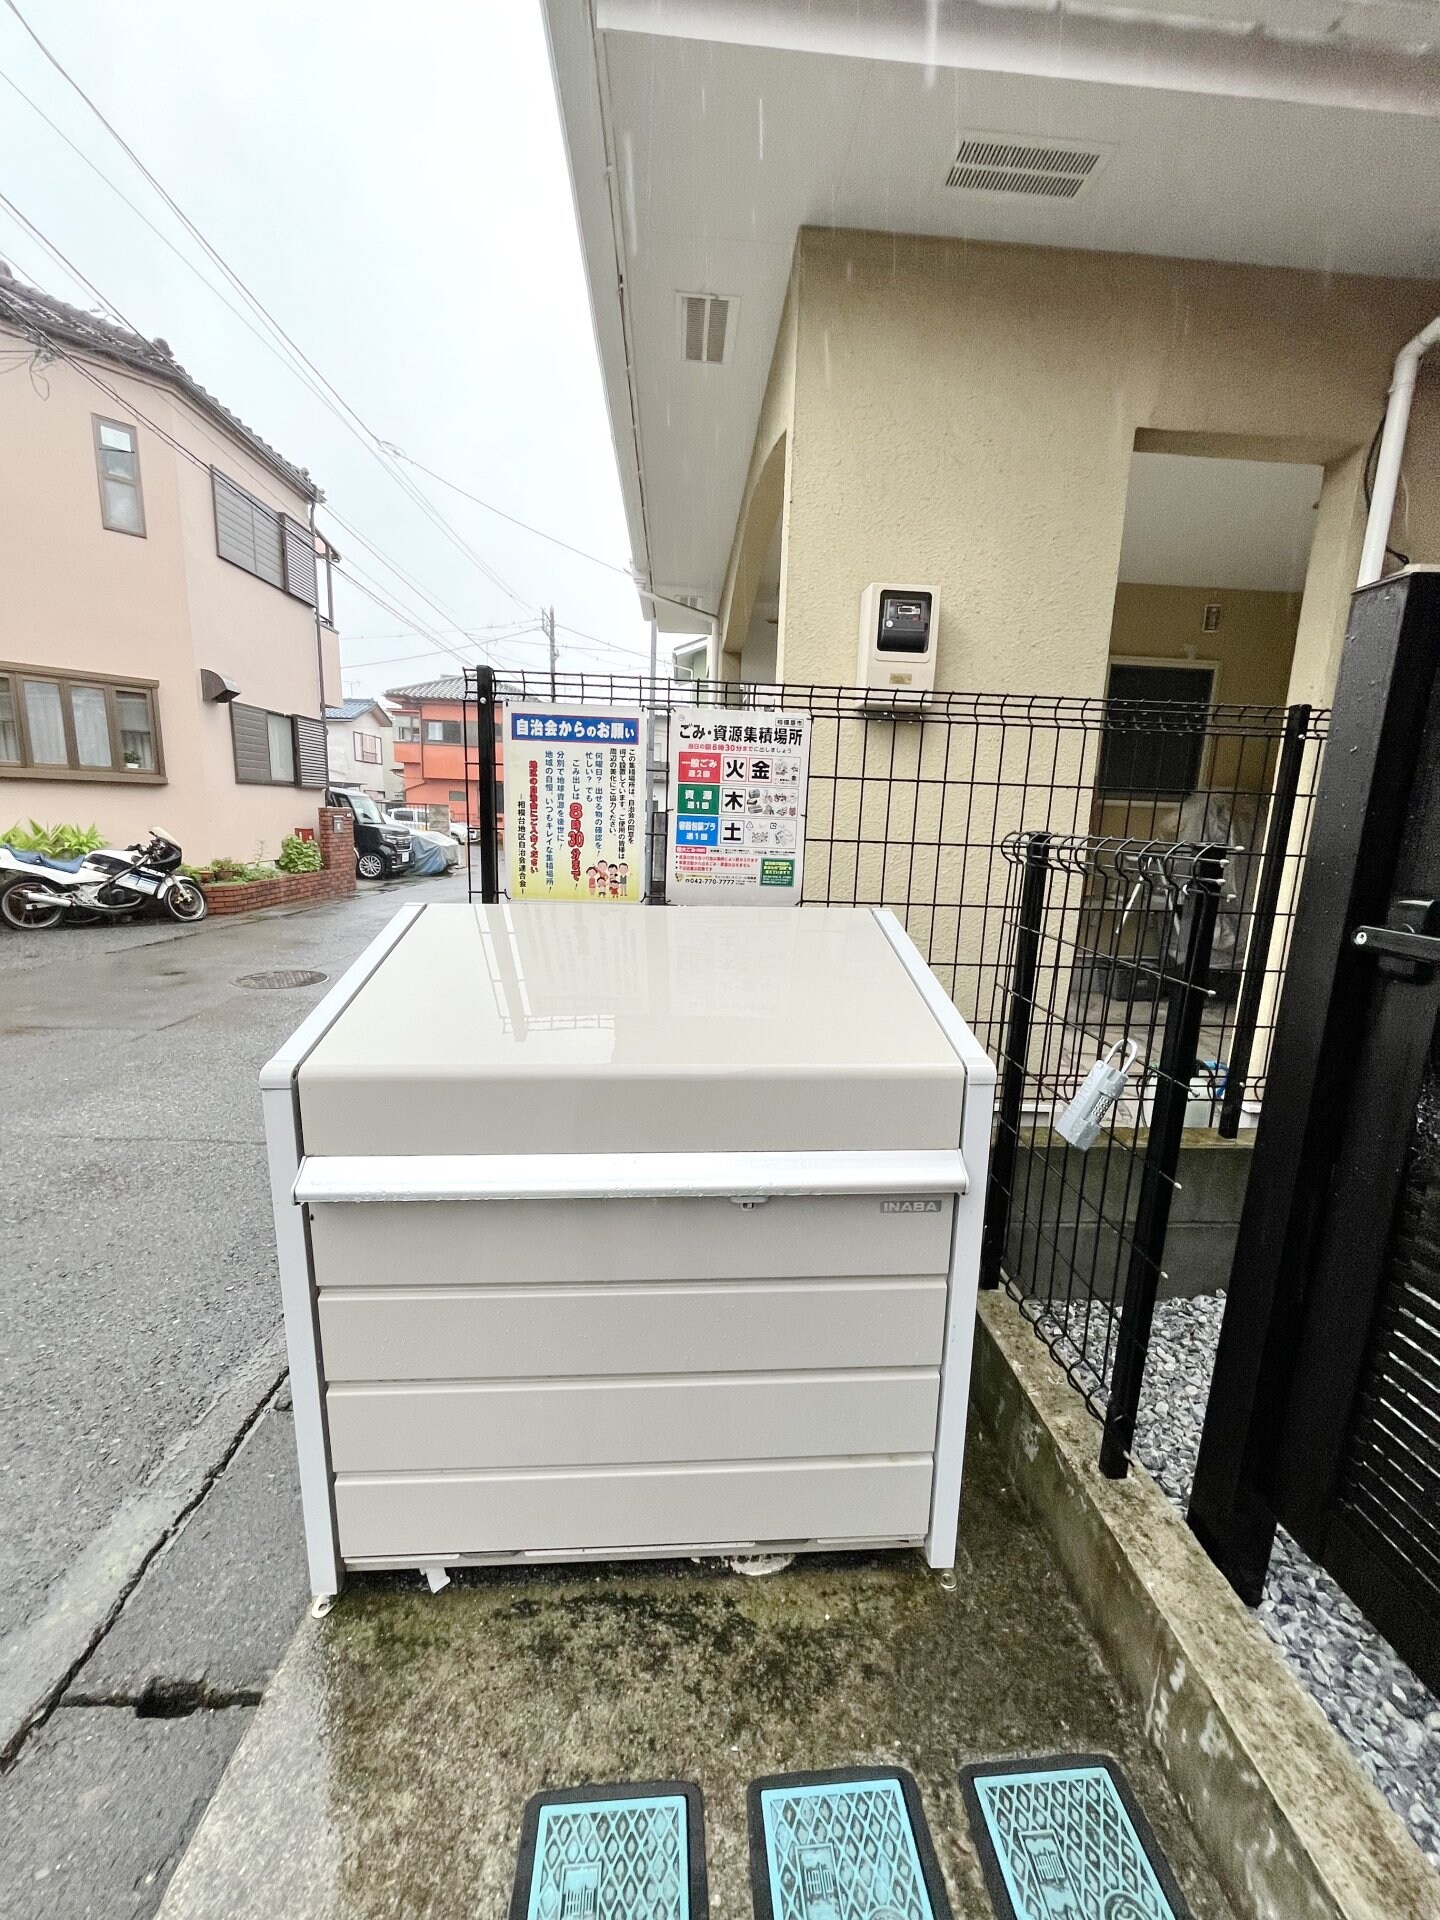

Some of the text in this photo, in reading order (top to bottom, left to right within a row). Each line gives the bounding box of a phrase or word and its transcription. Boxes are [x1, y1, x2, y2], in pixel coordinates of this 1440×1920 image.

[516, 719, 635, 739] 自治会からのお願い
[680, 724, 803, 746] ごみ・資源集積場所
[726, 760, 744, 778] 火
[751, 760, 770, 779] 金
[725, 791, 743, 810] 木
[723, 823, 741, 840] 土
[883, 1202, 938, 1212] INABA
